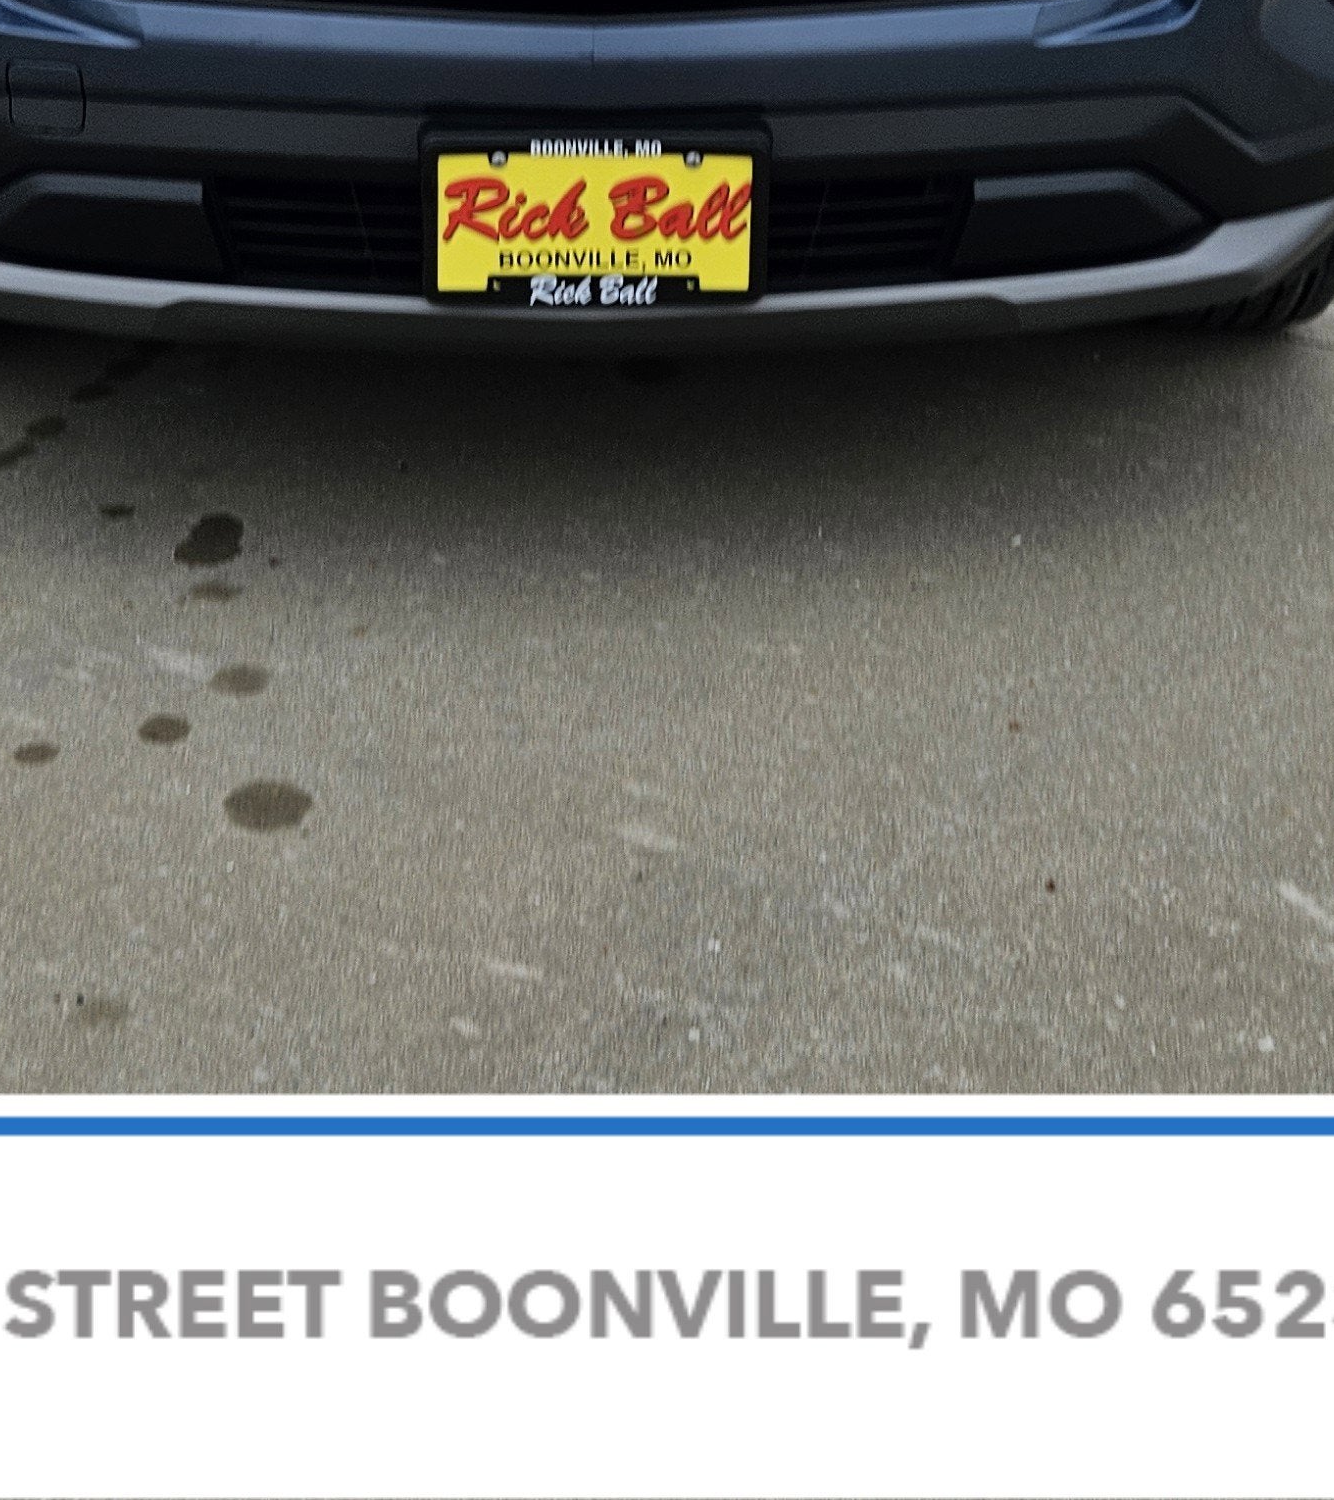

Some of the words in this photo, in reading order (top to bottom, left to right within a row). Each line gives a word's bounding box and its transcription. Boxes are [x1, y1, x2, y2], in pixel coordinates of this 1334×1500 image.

[530, 138, 630, 159] BOONVILLE,
[635, 138, 663, 158] MO
[442, 176, 590, 243] Rick
[609, 175, 753, 243] Ball
[499, 248, 646, 273] BOONVILLE,
[654, 248, 693, 270] MO
[530, 274, 592, 306] Rick
[599, 274, 658, 307] Ball
